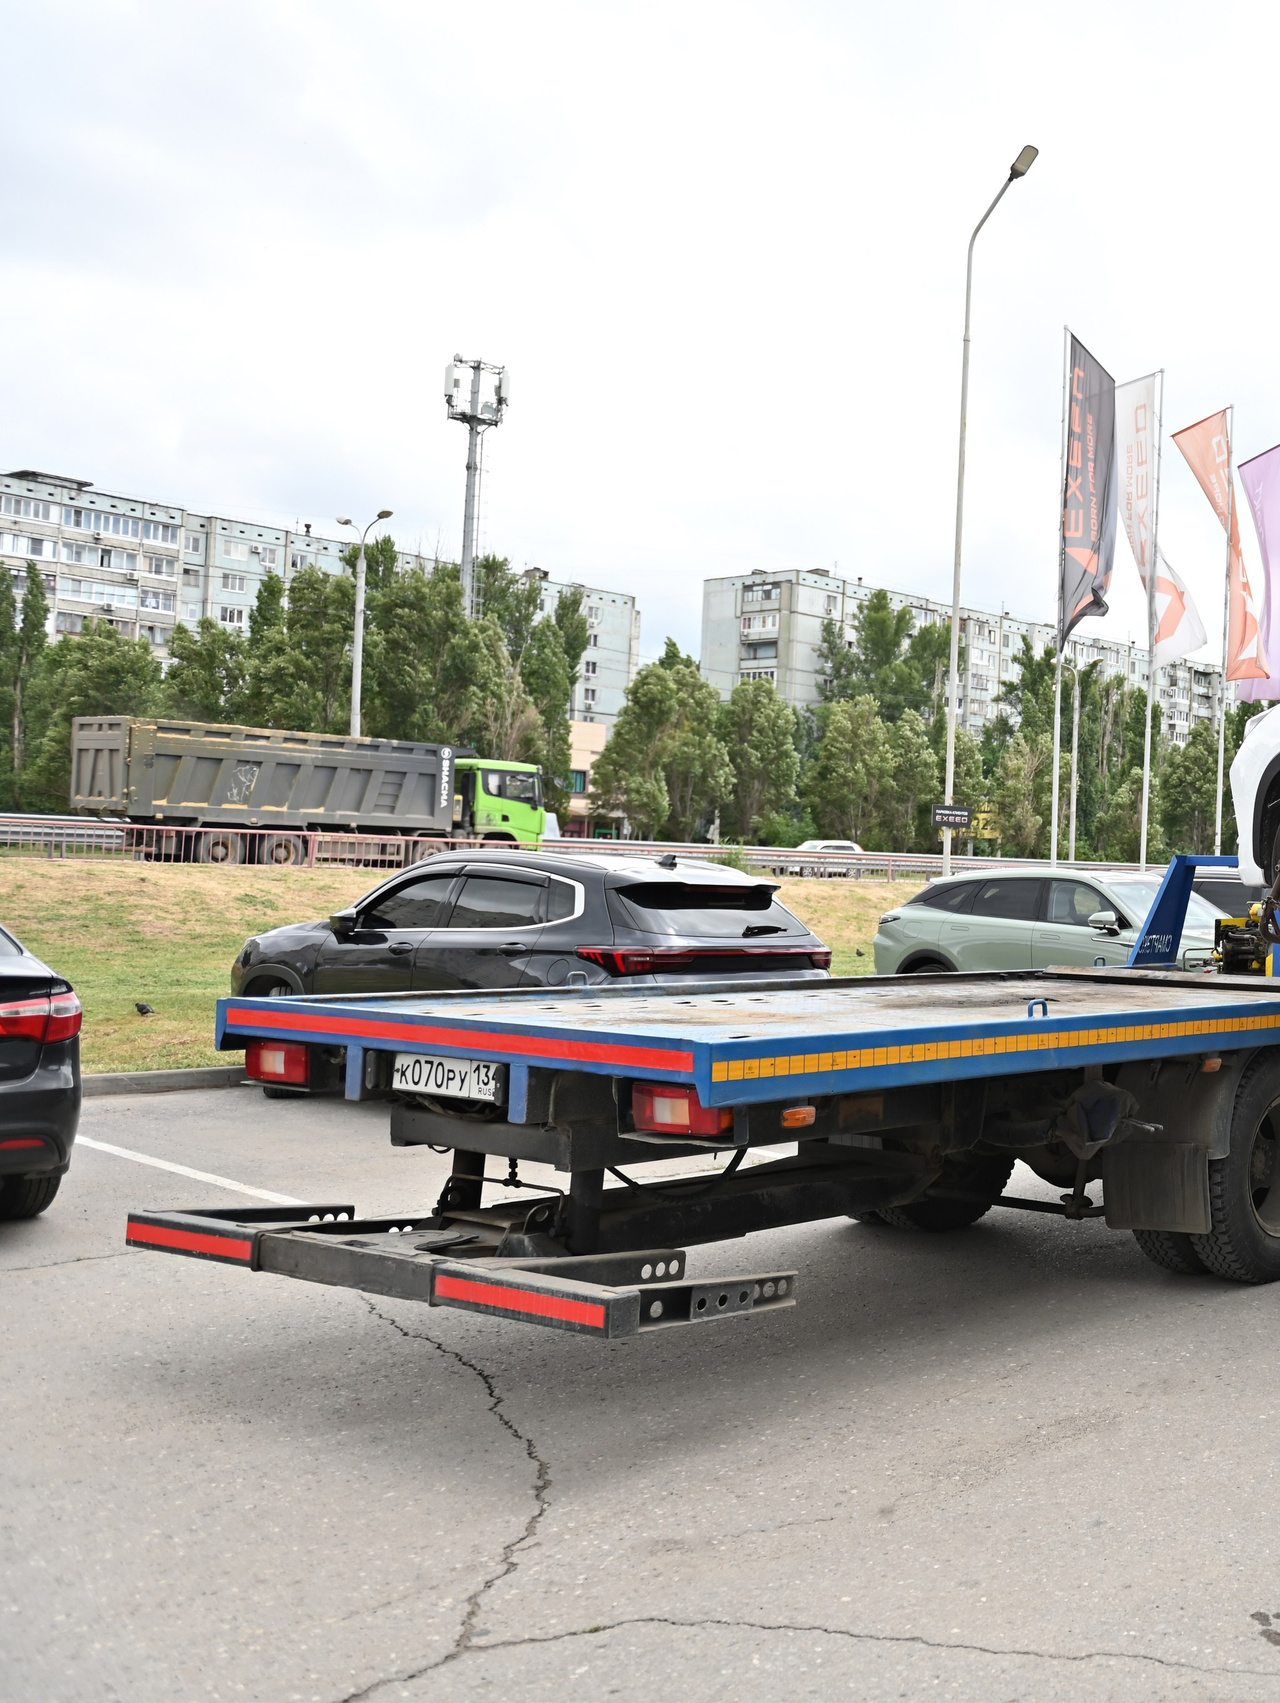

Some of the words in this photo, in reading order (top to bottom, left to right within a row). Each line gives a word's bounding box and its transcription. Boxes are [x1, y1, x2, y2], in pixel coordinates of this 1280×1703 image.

[1086, 413, 1095, 458] MORE
[1087, 461, 1096, 493] FOR
[936, 815, 968, 823] EXEED
[478, 1087, 492, 1096] RUS
